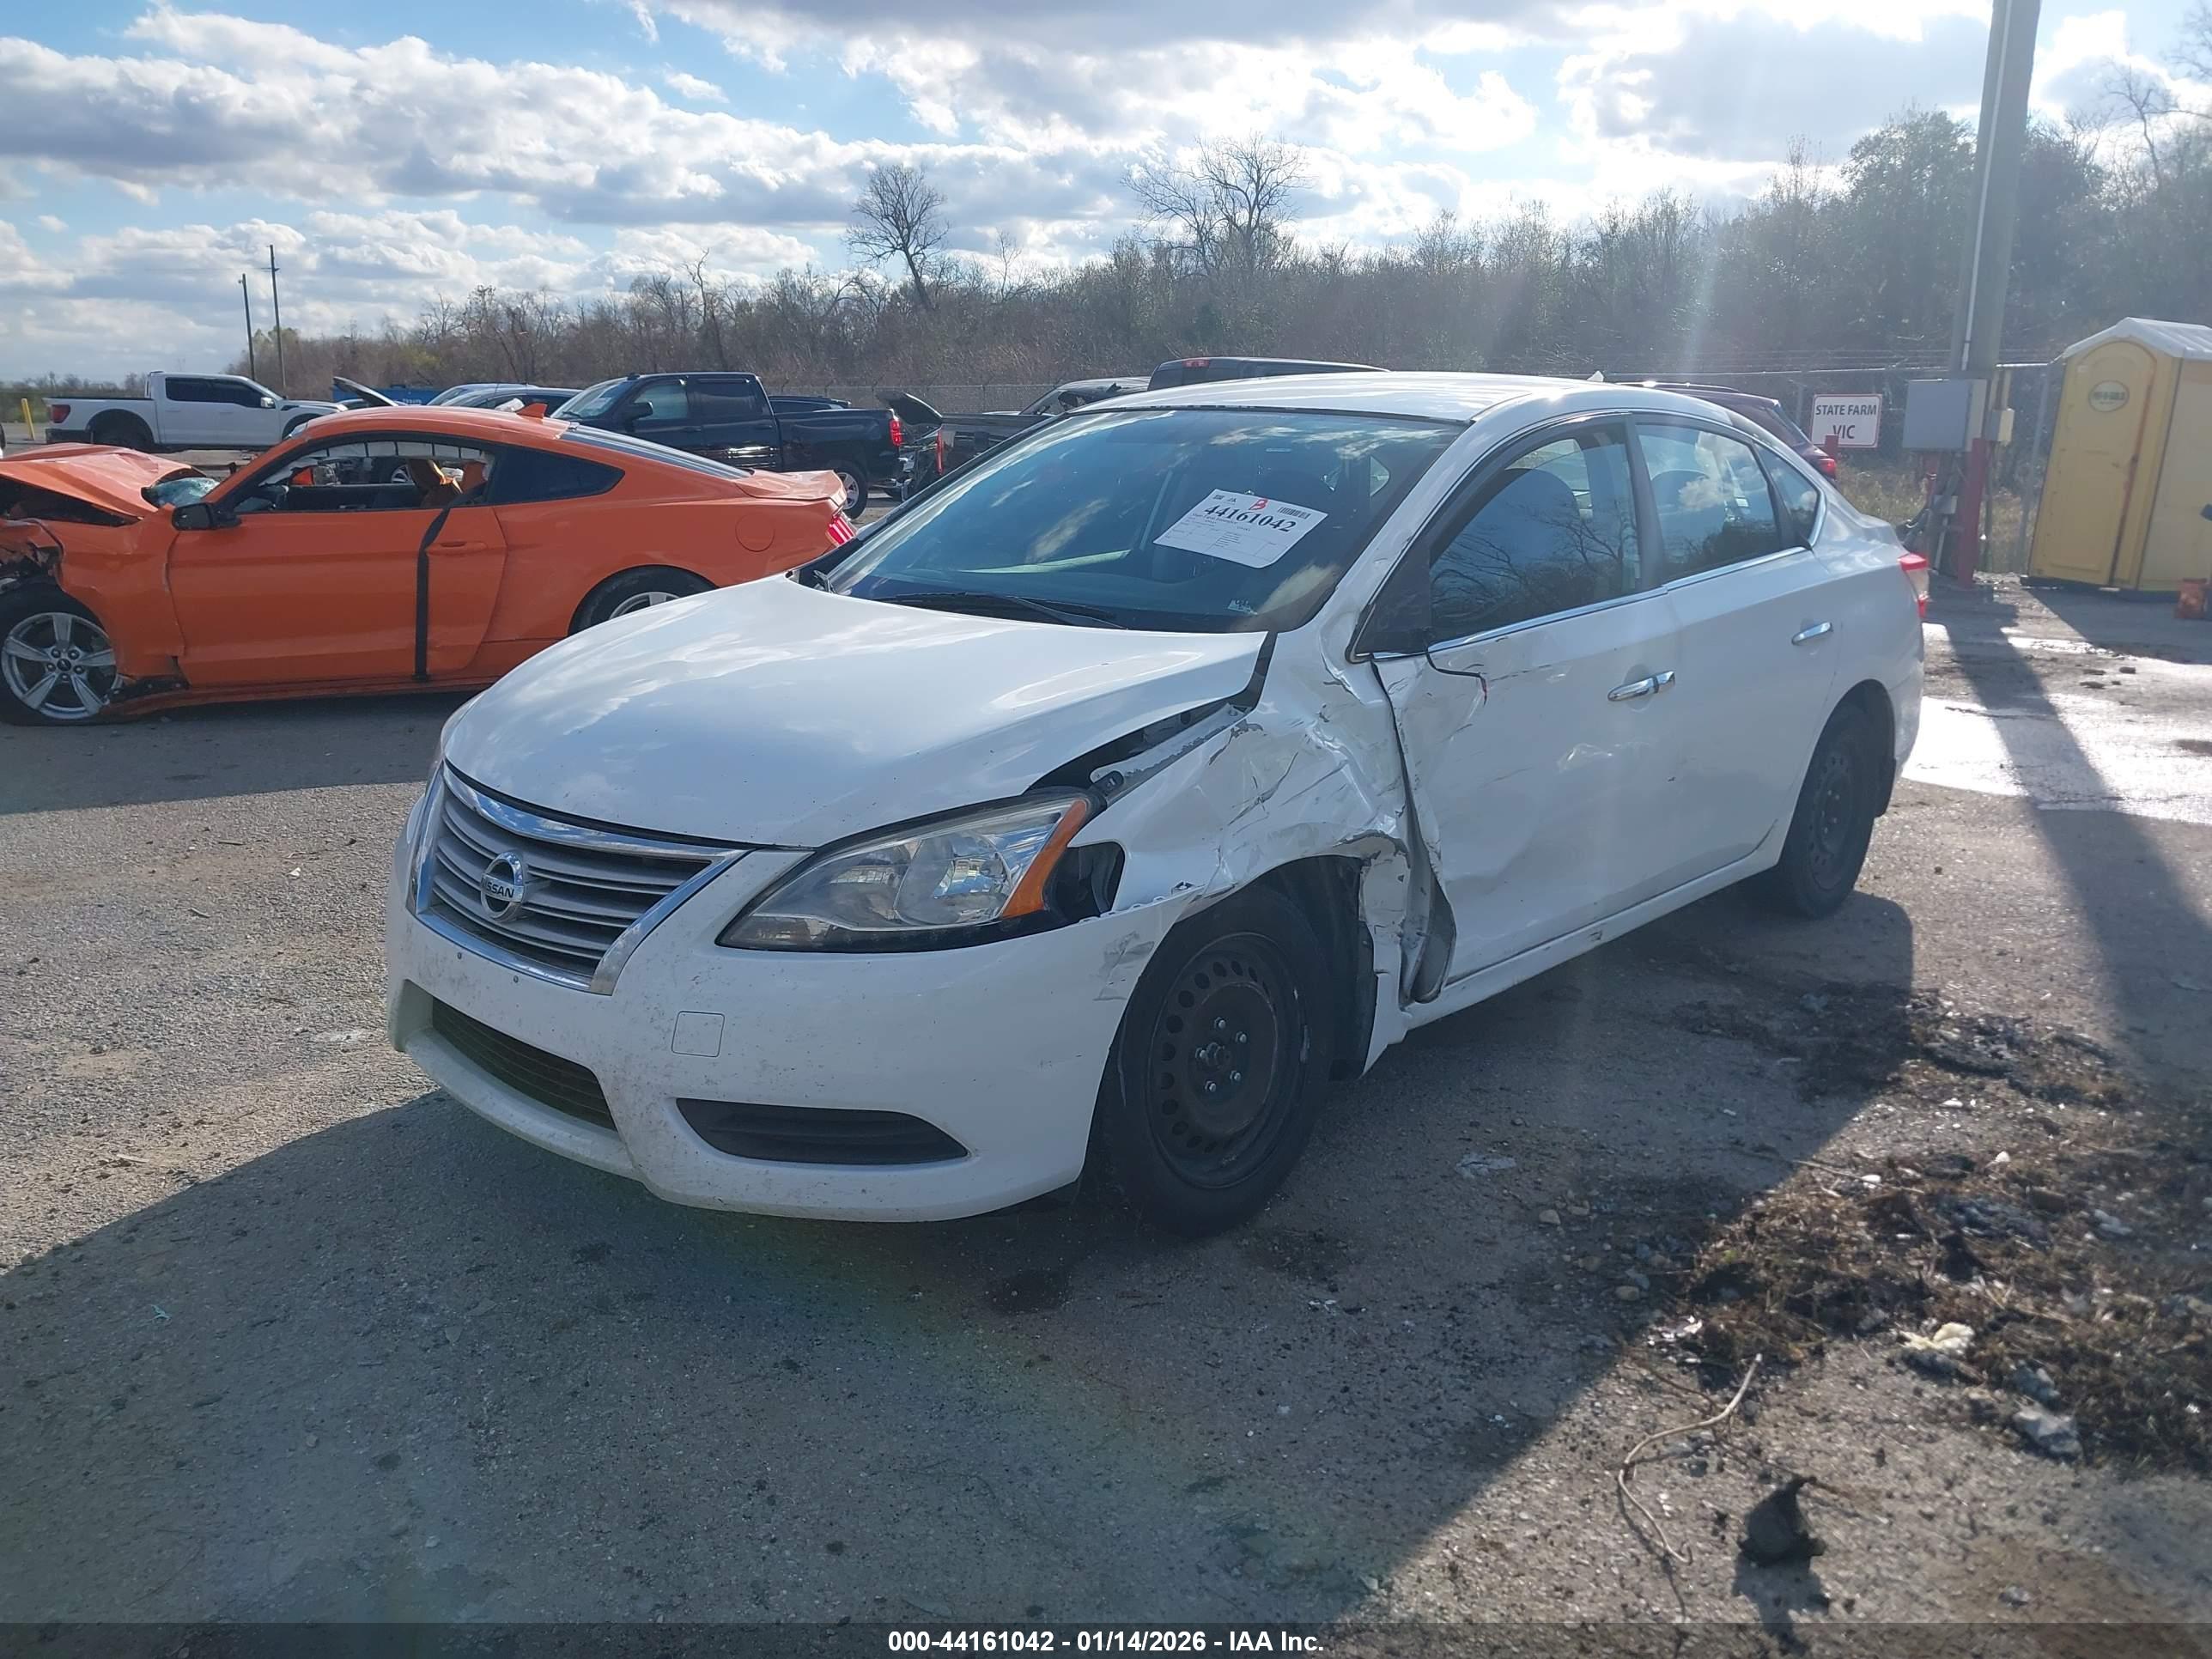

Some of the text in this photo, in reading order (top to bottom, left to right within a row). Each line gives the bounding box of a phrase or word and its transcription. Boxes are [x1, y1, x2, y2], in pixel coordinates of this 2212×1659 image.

[1815, 404, 1877, 416] STATE FARM
[1832, 424, 1856, 440] VIC
[1204, 504, 1297, 533] 44161042
